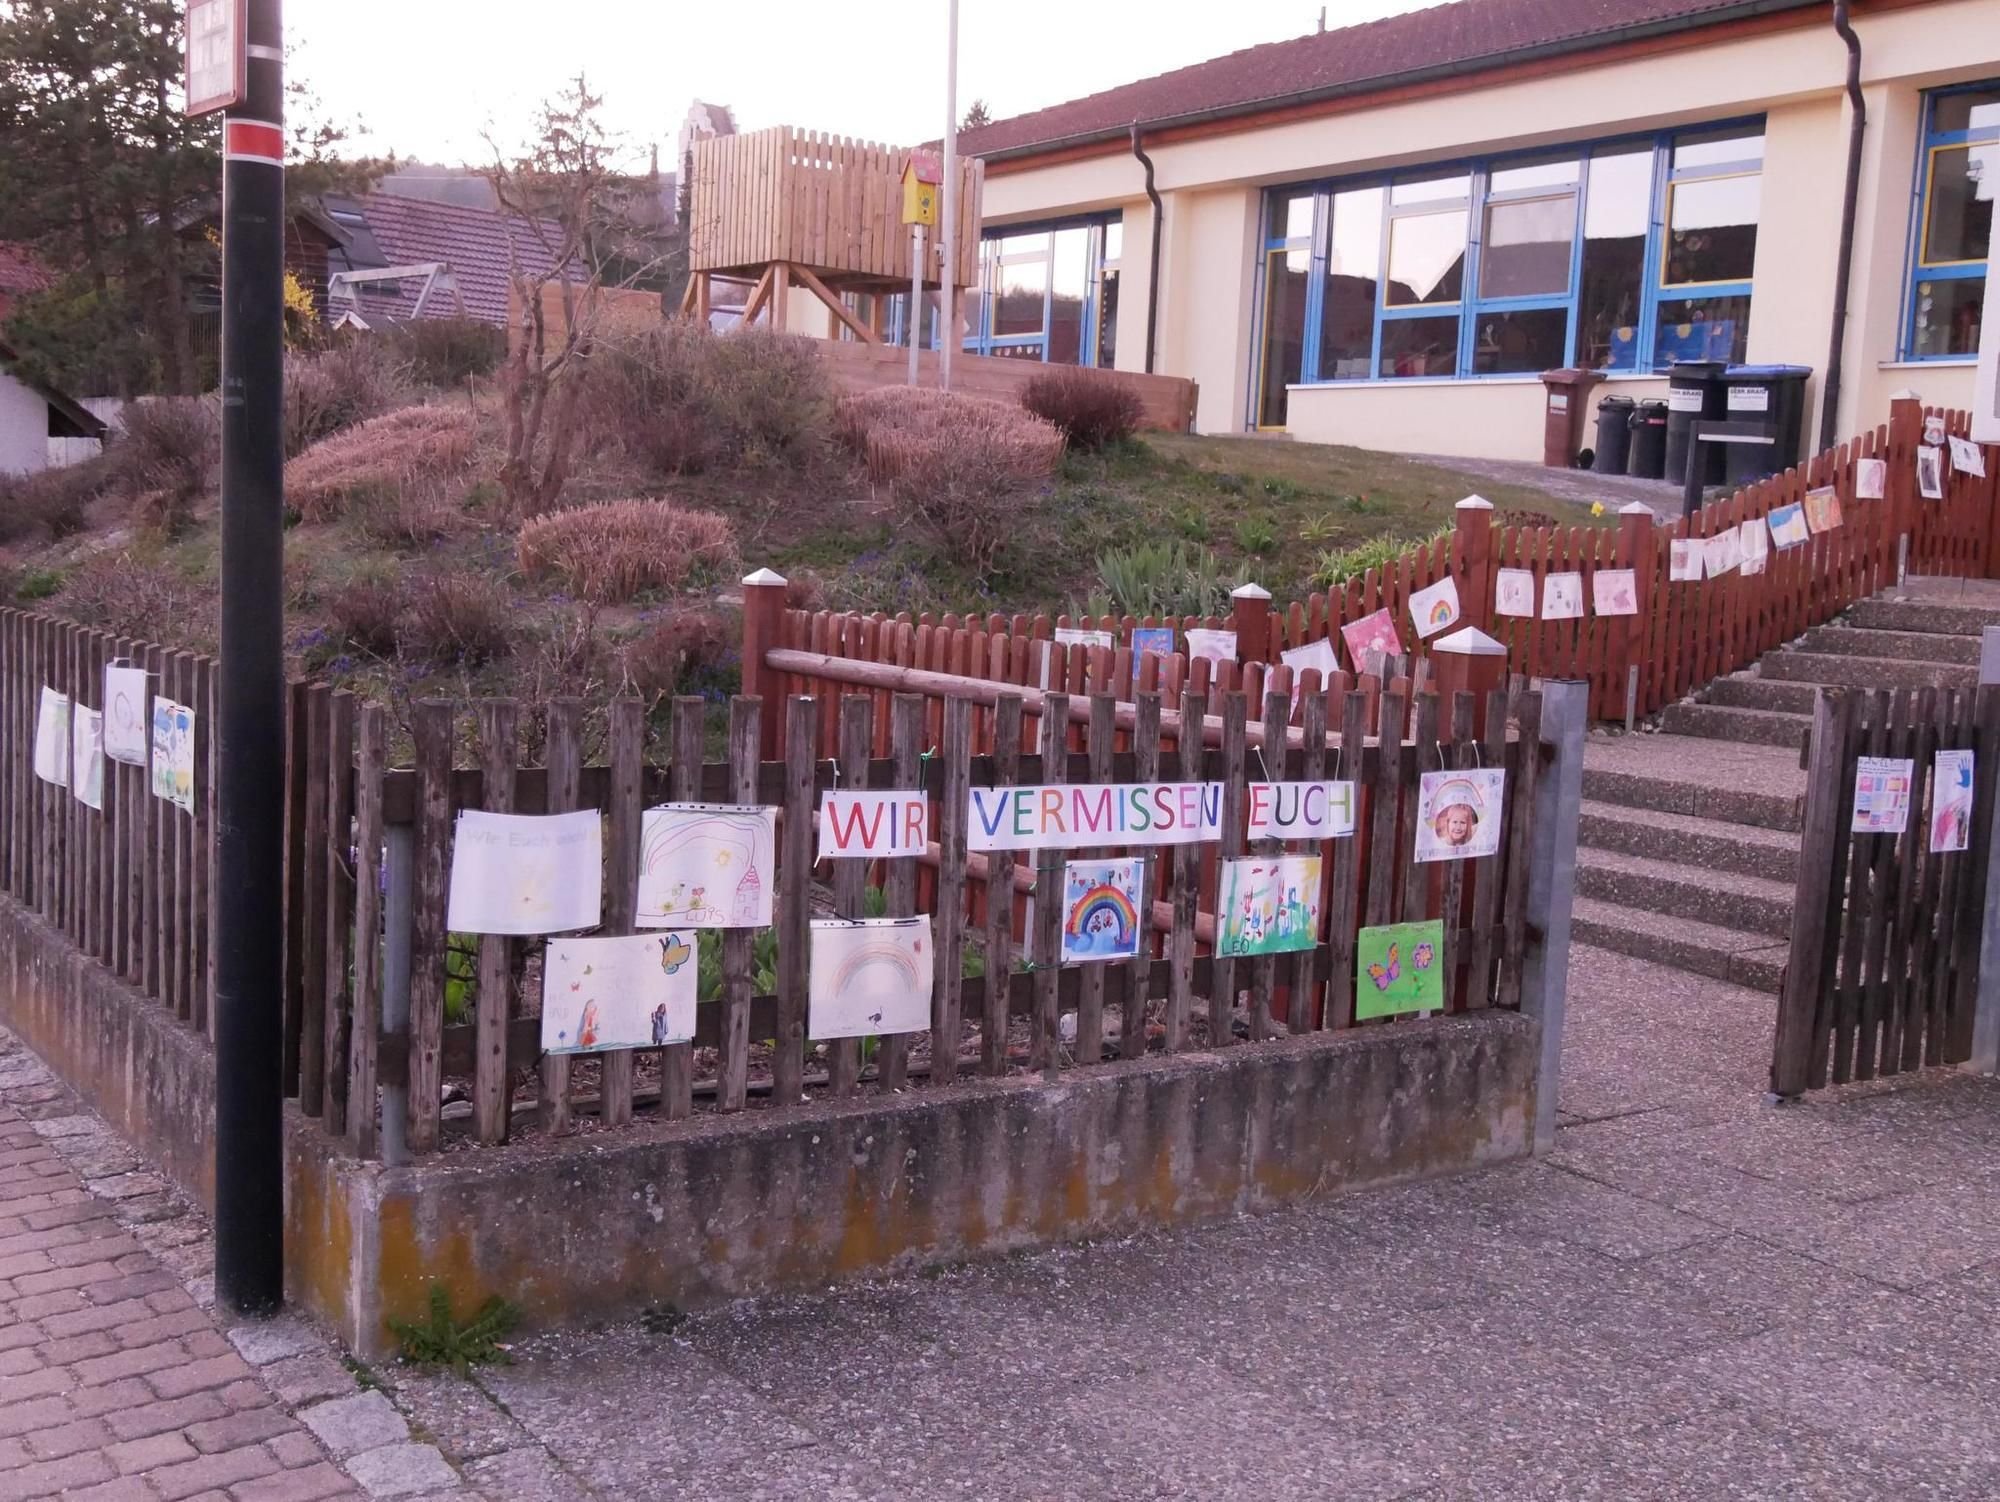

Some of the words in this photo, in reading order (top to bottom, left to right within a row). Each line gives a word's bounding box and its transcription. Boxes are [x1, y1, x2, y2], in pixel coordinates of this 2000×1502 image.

[827, 801, 924, 850] WIR
[973, 784, 1220, 836] VERMISSEN
[1250, 784, 1351, 827] EUCH
[1221, 937, 1250, 955] LEO
